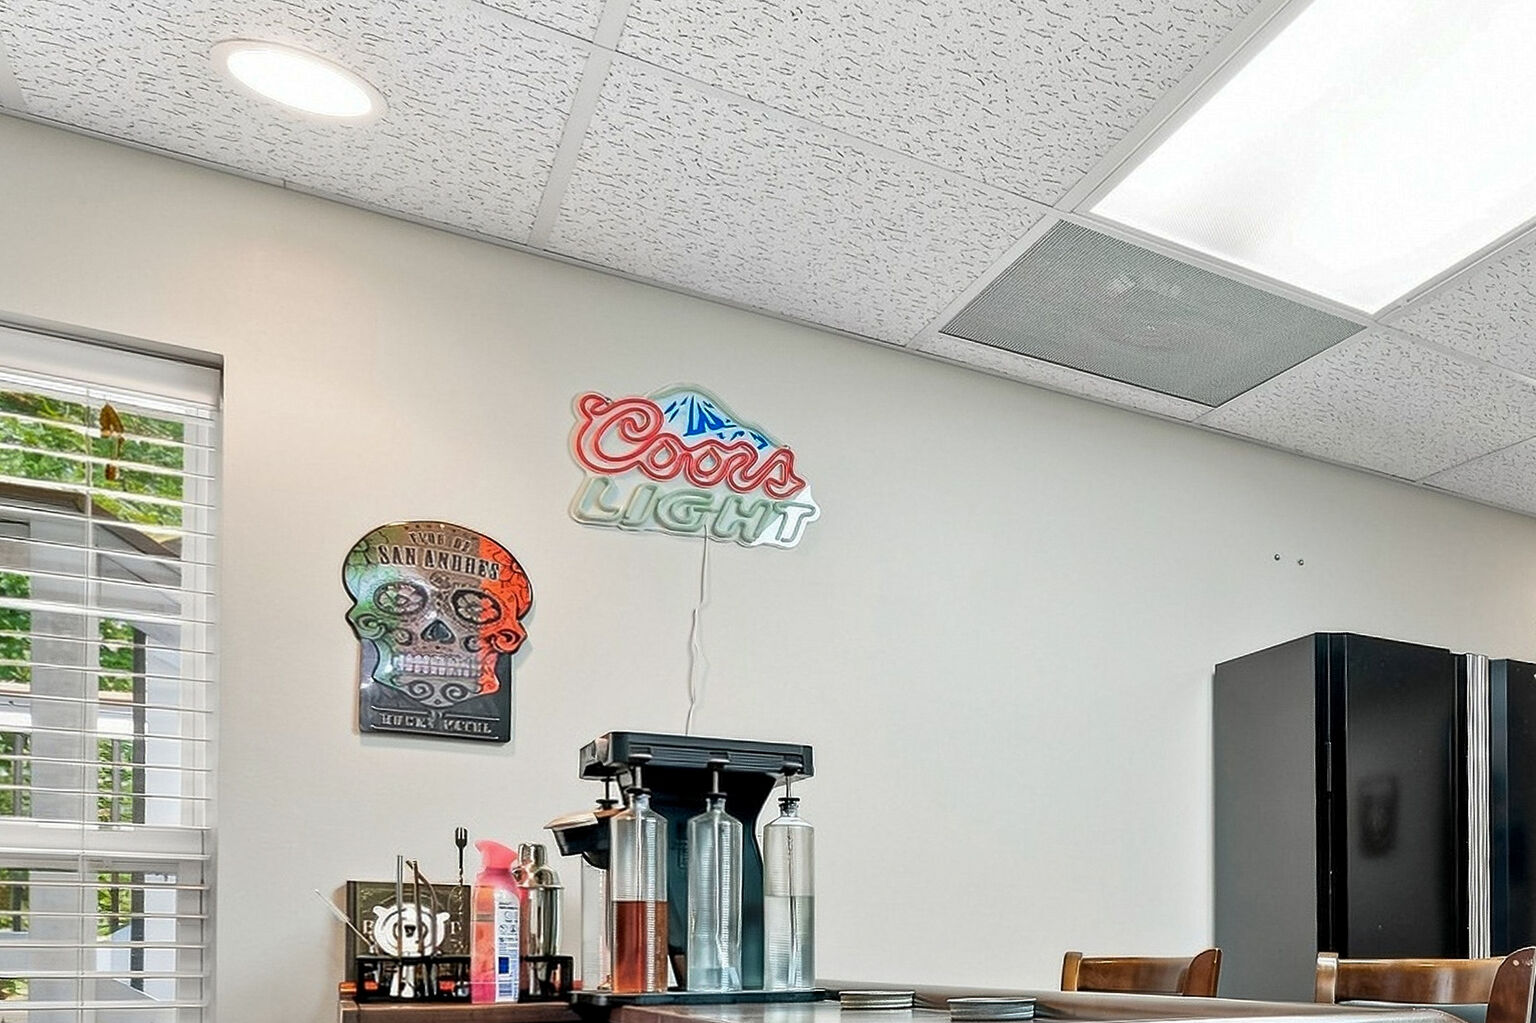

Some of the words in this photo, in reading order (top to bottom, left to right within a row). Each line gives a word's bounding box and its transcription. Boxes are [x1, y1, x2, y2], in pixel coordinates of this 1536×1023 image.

[573, 390, 807, 499] Coors
[576, 477, 817, 545] LIGHT
[377, 544, 417, 566] SAN
